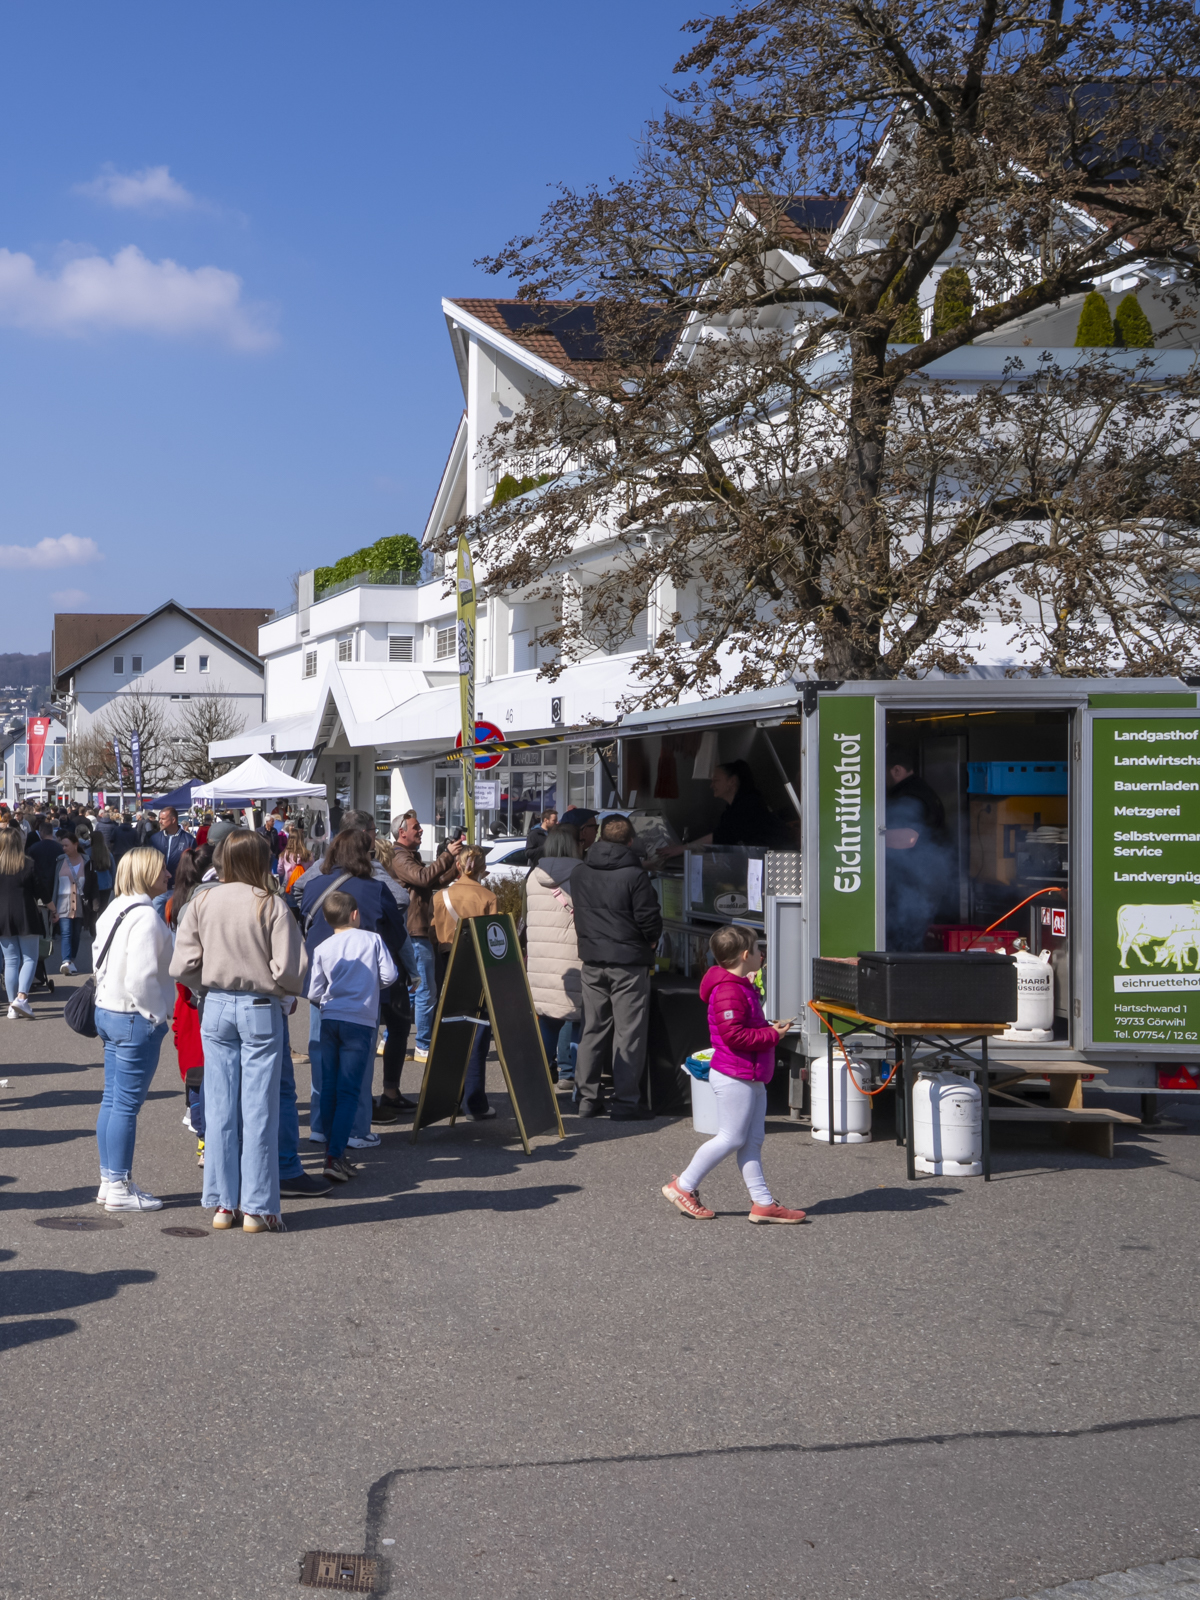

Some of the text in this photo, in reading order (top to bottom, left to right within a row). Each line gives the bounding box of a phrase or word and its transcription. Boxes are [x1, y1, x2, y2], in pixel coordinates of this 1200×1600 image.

[505, 708, 514, 724] 46
[1113, 730, 1199, 743] Landgasthof
[1113, 780, 1200, 791] Bauernladen
[833, 733, 861, 893] Eichrüttehof
[1113, 805, 1181, 818] Metzgerei
[1113, 846, 1163, 857] Service
[1114, 1004, 1188, 1013] Hartschwand 1
[1115, 1017, 1186, 1027] 79733 Görwihl
[1113, 1030, 1131, 1039] Tel.
